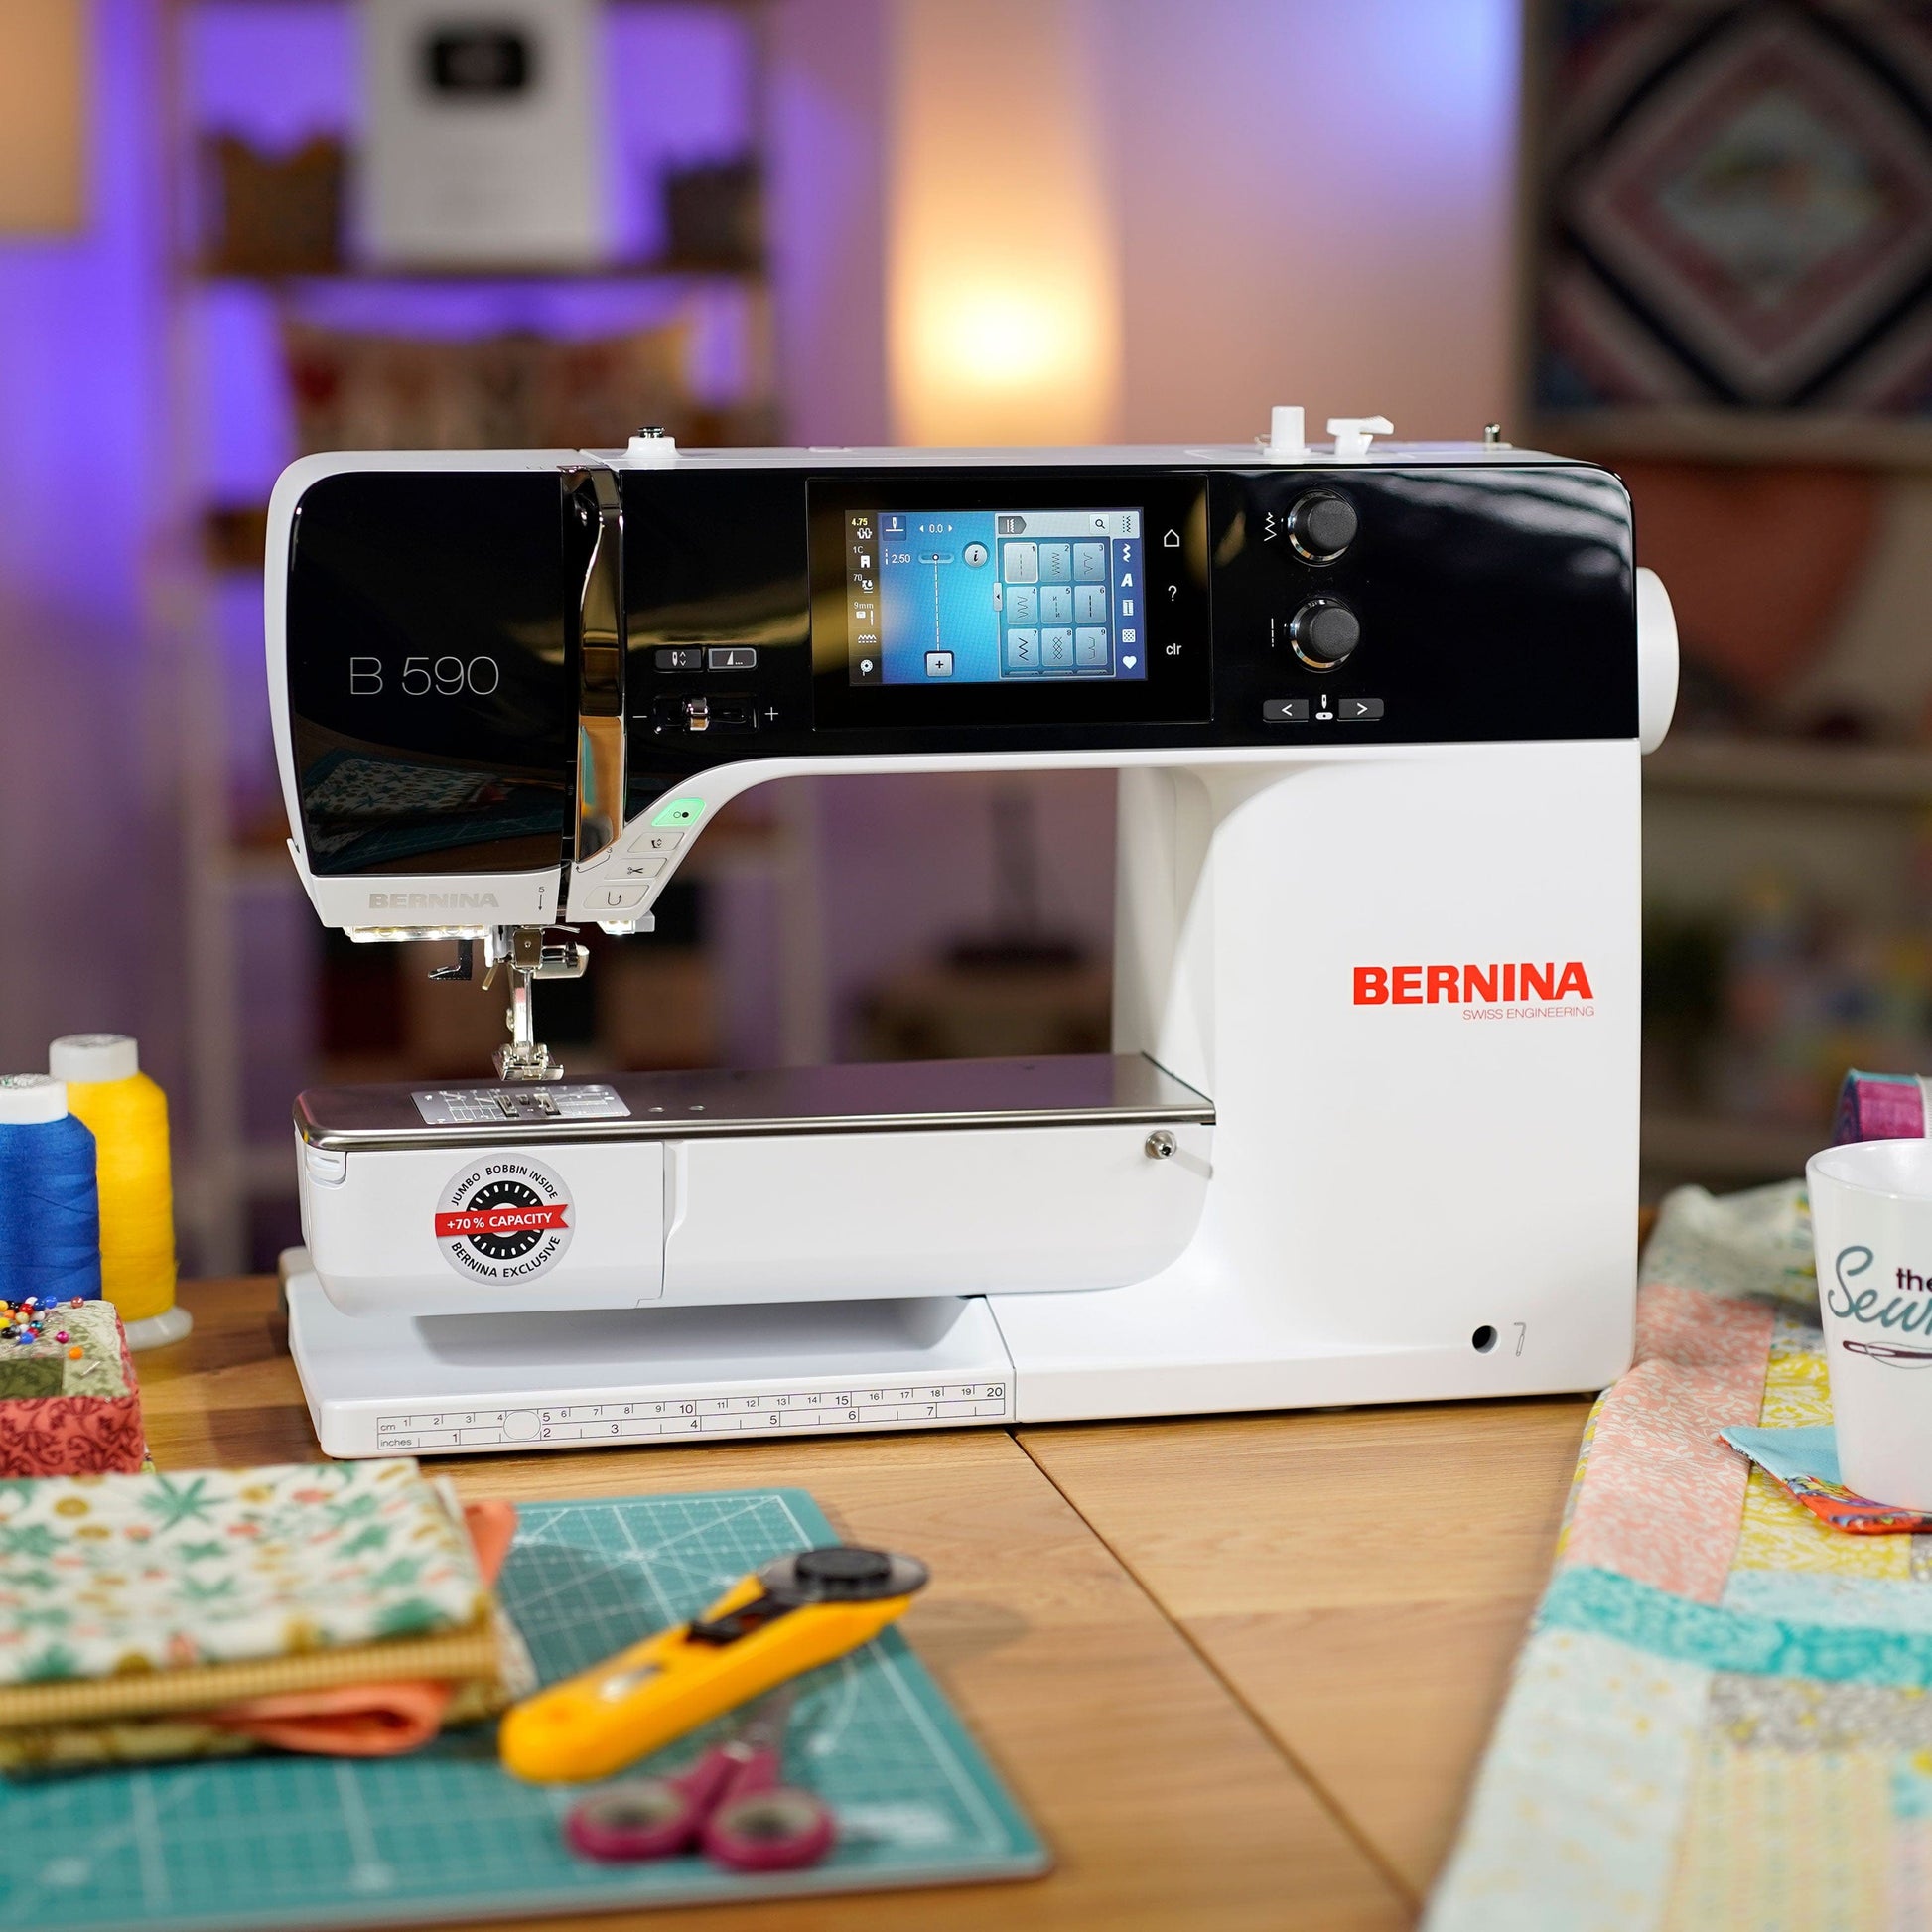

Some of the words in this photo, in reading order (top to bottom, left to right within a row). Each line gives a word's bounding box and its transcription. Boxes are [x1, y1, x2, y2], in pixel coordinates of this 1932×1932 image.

[929, 524, 943, 533] 0.0
[892, 554, 911, 564] 2.50
[1121, 573, 1133, 587] A
[1166, 643, 1182, 656] clr
[350, 657, 383, 695] B
[401, 656, 499, 695] 590
[368, 893, 500, 909] BERNINA
[1353, 962, 1594, 1005] BERNINA
[1462, 1009, 1504, 1021] SWISS
[1506, 1006, 1595, 1019] ENGINEERING
[451, 1173, 481, 1206] JUMBO
[485, 1164, 528, 1176] BOBBIN
[529, 1171, 558, 1199] INSIDE
[447, 1218, 471, 1230] +70
[473, 1217, 485, 1228] %
[488, 1212, 553, 1227] CAPACITY
[451, 1241, 498, 1278] BERNINA
[502, 1235, 561, 1278] EXCLUSIVE
[1828, 1245, 1932, 1336] Sew
[542, 1412, 551, 1422] 5
[679, 1404, 694, 1414] 10
[836, 1395, 849, 1406] 15
[987, 1387, 1003, 1397] 20
[380, 1438, 412, 1447] inches
[452, 1434, 458, 1443] 1
[543, 1428, 551, 1438] 2
[611, 1424, 619, 1434] 3
[690, 1420, 698, 1429] 4
[769, 1415, 778, 1425] 5
[848, 1411, 857, 1420] 6
[927, 1406, 934, 1416] 7
